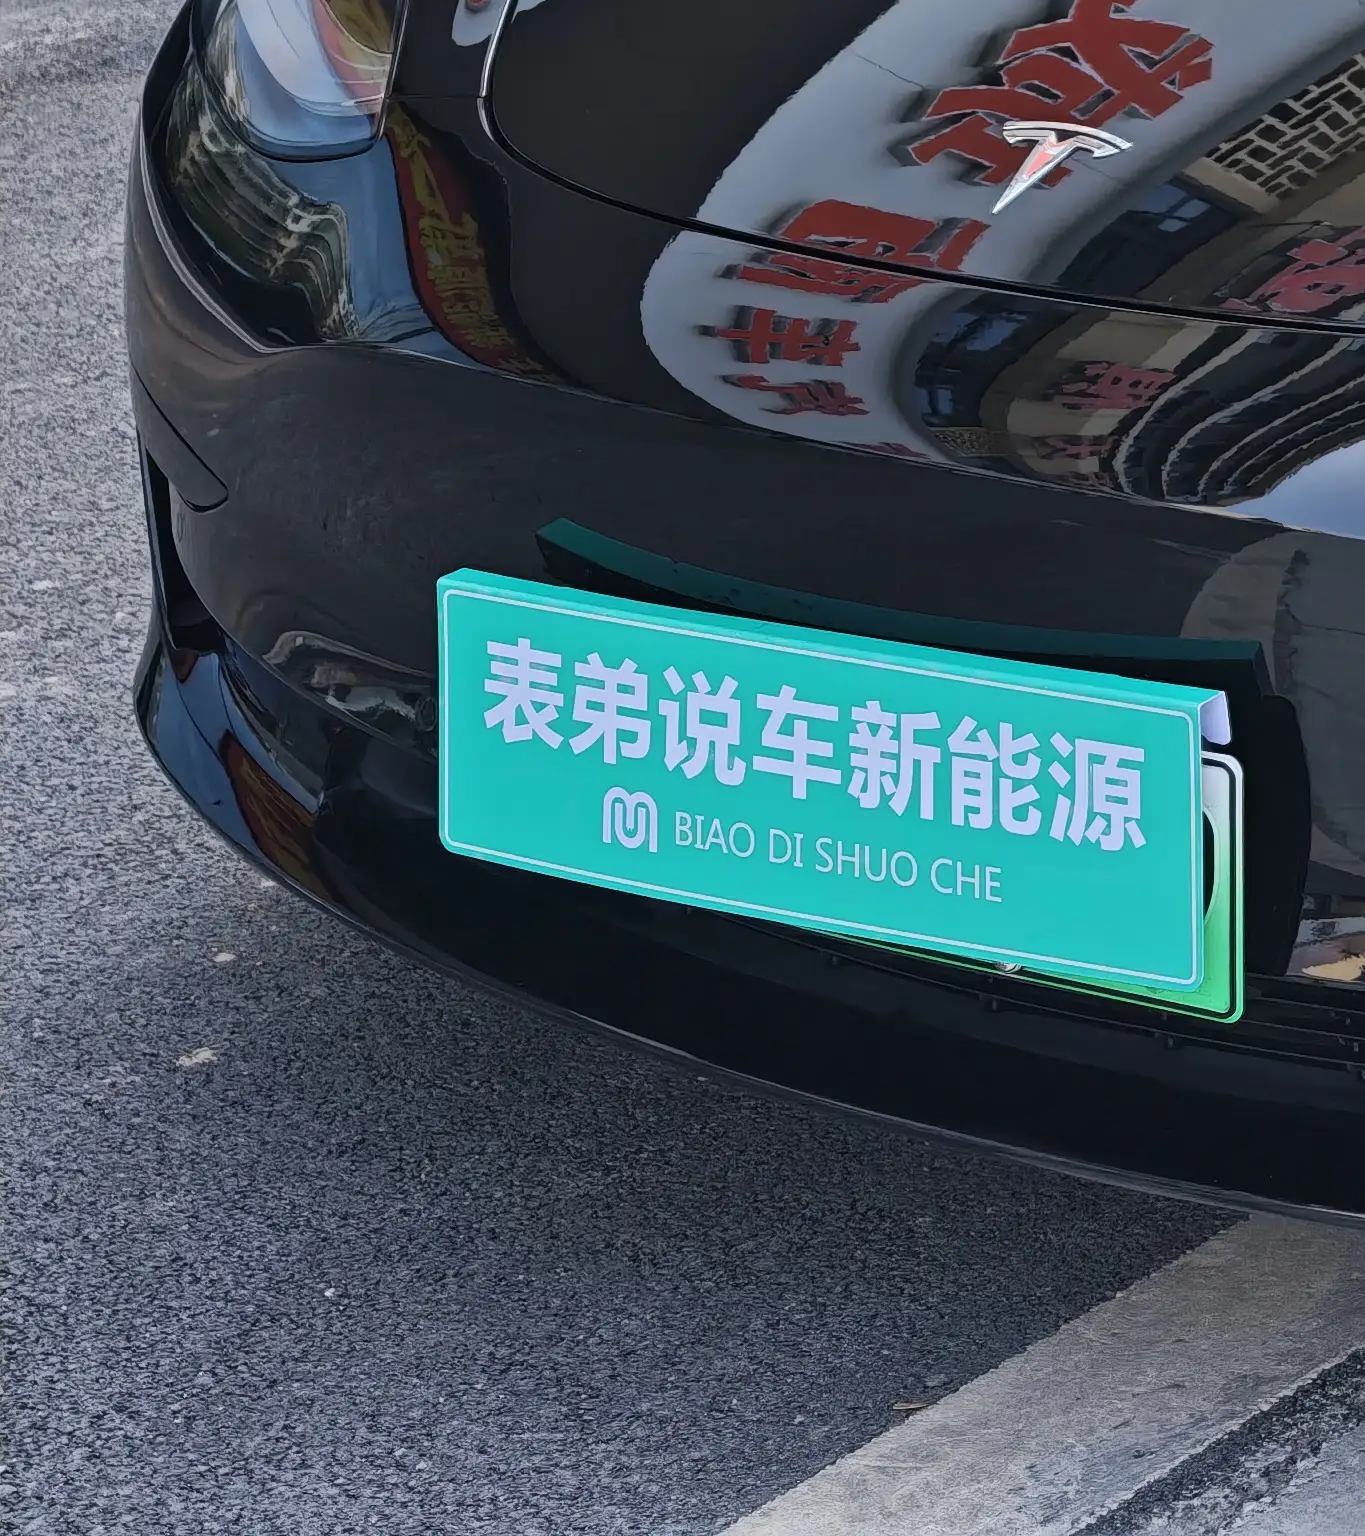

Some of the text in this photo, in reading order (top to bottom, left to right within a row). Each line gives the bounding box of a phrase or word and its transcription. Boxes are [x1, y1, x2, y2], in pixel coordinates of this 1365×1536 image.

[484, 638, 1147, 852] 表弟说车新能源
[675, 811, 1002, 902] BIAO DI SHUO CHE
